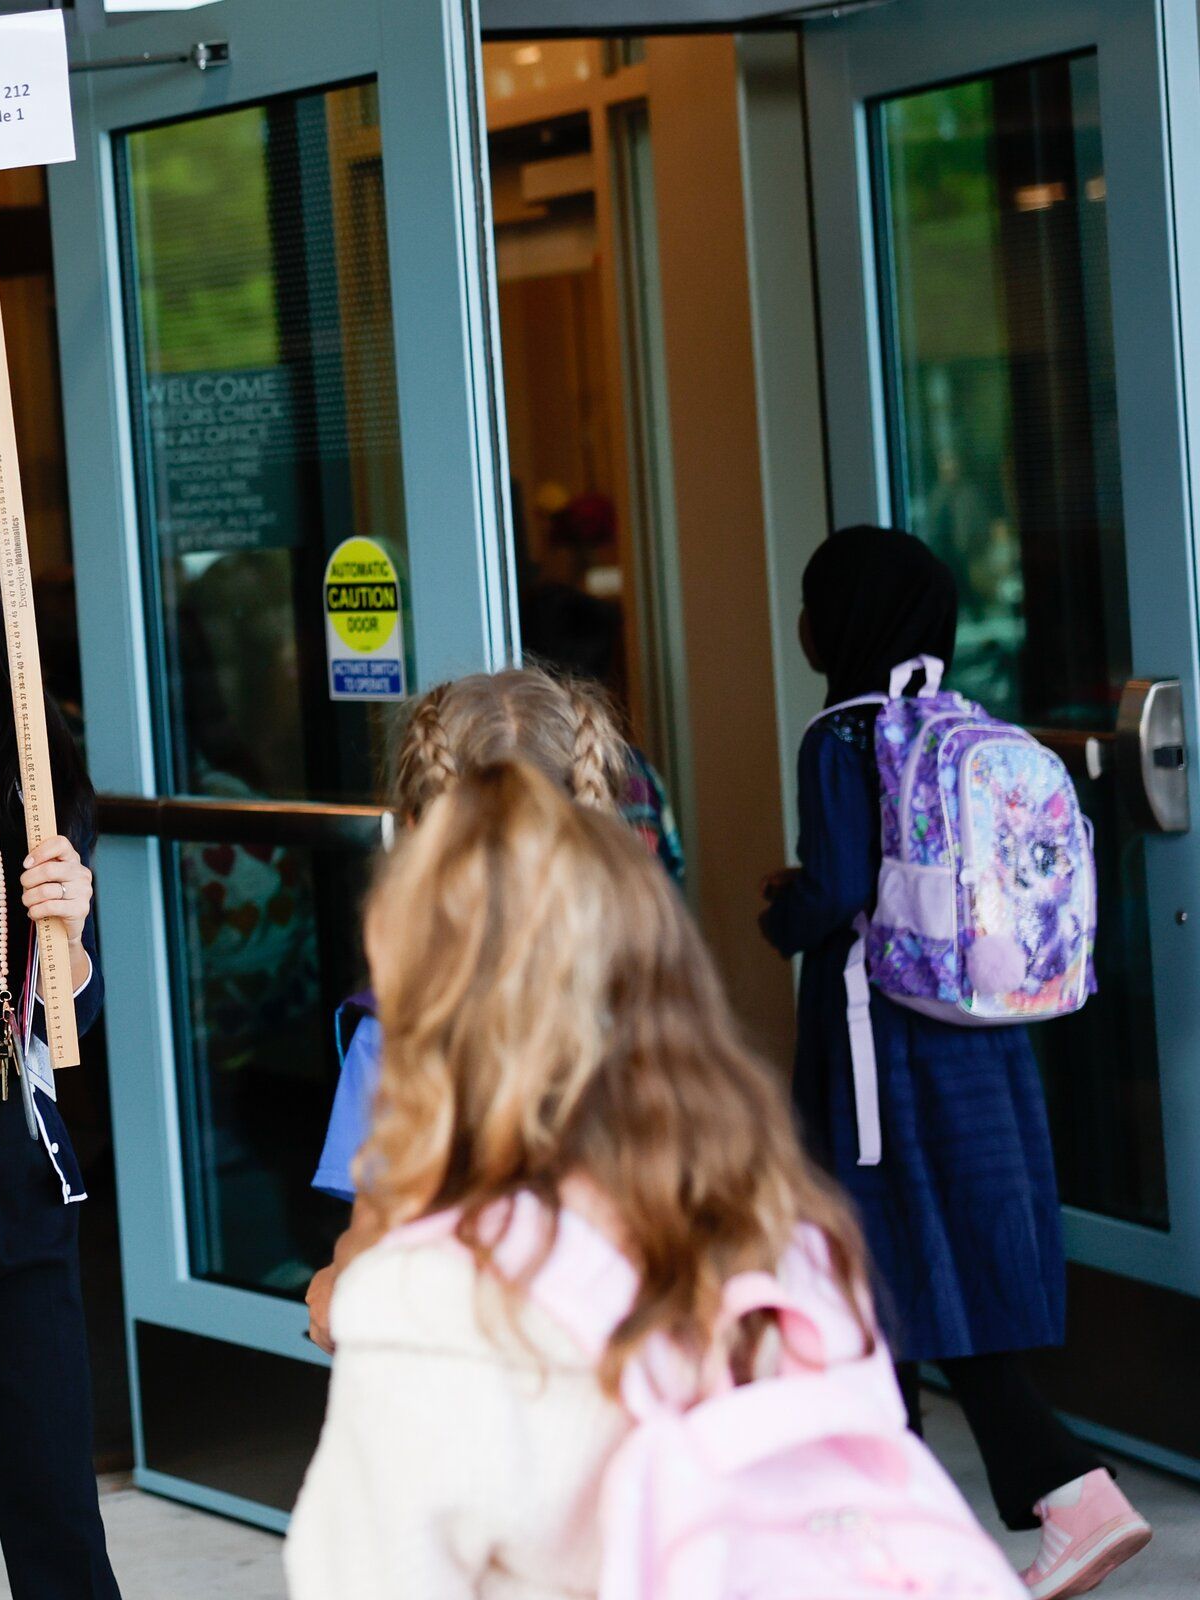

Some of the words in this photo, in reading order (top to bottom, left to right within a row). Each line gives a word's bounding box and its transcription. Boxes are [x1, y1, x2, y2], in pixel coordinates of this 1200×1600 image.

[4, 83, 31, 99] 212
[16, 108, 24, 121] 1
[144, 374, 278, 405] WELCOME
[331, 561, 389, 577] AUTOMATIC
[16, 567, 28, 608] Everyday
[328, 588, 395, 609] CAUTION
[347, 616, 379, 633] DOOR
[371, 663, 400, 675] SWITCH
[356, 677, 390, 692] OPERATE
